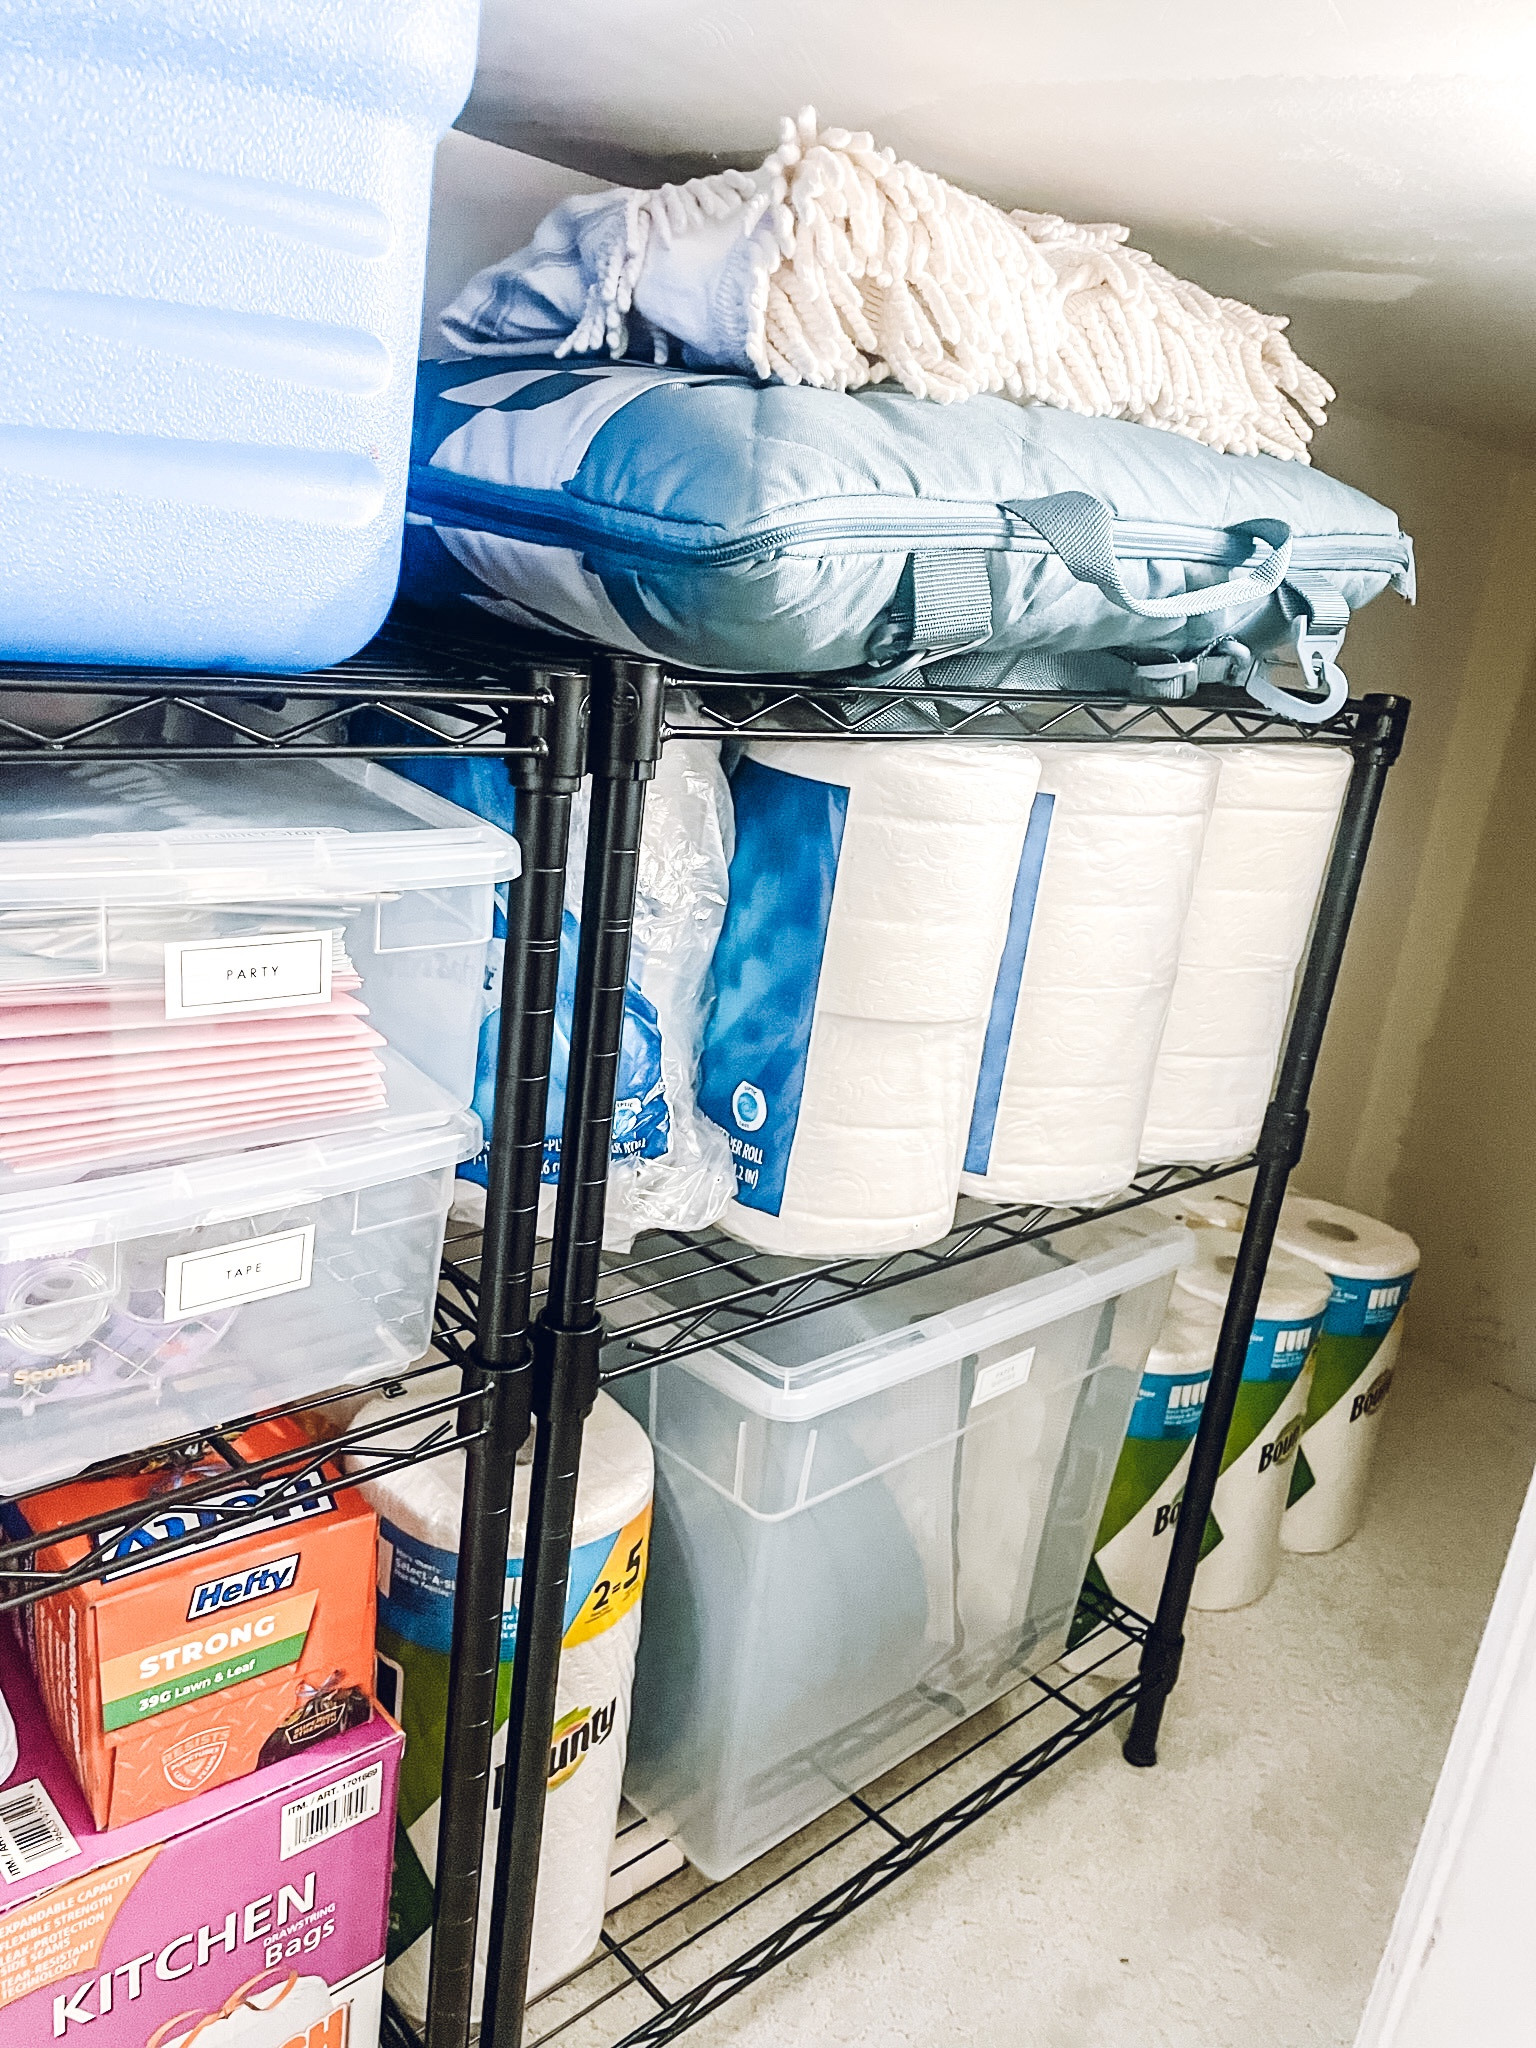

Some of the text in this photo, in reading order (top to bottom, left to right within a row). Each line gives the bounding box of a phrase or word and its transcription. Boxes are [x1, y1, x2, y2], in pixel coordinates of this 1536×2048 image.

[226, 965, 280, 981] PARTY
[742, 1142, 764, 1165] ROLL
[225, 1262, 262, 1280] TAPE
[13, 1357, 92, 1386] Scotch
[195, 1565, 293, 1612] Hefty
[139, 1614, 276, 1680] STRONG
[138, 1658, 257, 1713] 39G Lawn & Leaf
[287, 1801, 309, 1817] ITM.
[317, 1787, 340, 1802] ART.
[0, 1870, 132, 1937] EXPANDABLE CAPACITY
[0, 1893, 113, 1952] FLEXIBLE STRENGTH
[263, 1902, 336, 1948] DRAWSTRING
[0, 1936, 71, 1977] SIDE SEAMS
[1, 1938, 96, 1990] TEAR-RESISTANT
[53, 1871, 316, 2039] KITCHEN
[265, 1918, 335, 1969] Bags
[1, 1956, 79, 2000] TECHNOLOGY
